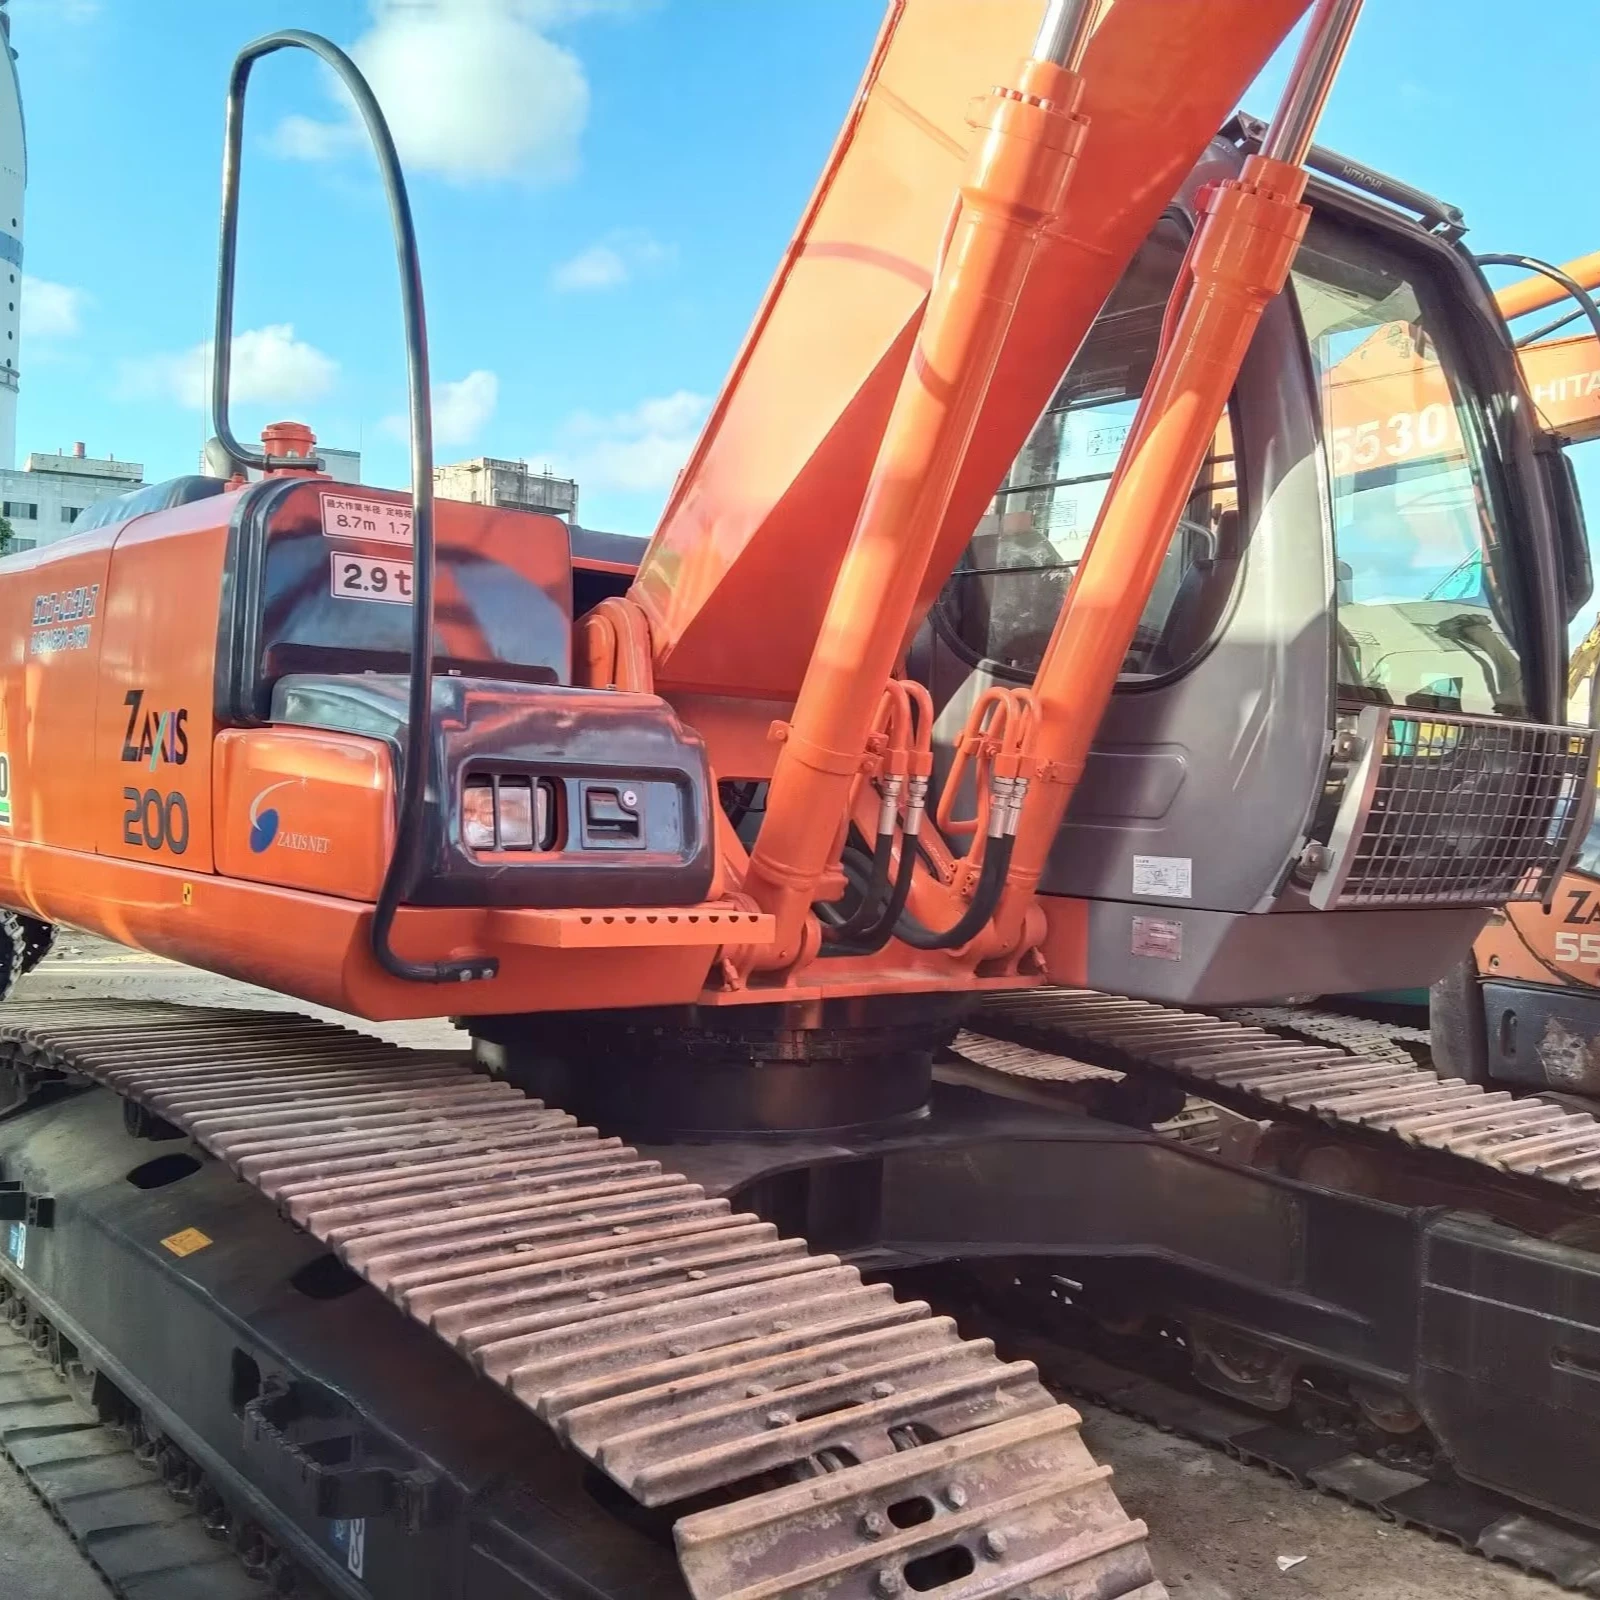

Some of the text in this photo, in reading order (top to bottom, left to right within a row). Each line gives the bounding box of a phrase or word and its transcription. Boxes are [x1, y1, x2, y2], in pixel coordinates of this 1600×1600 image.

[1341, 164, 1383, 190] HITACHI
[326, 499, 382, 515] 最大作業半径
[121, 689, 189, 772] ZAXIS
[123, 786, 190, 855] 200
